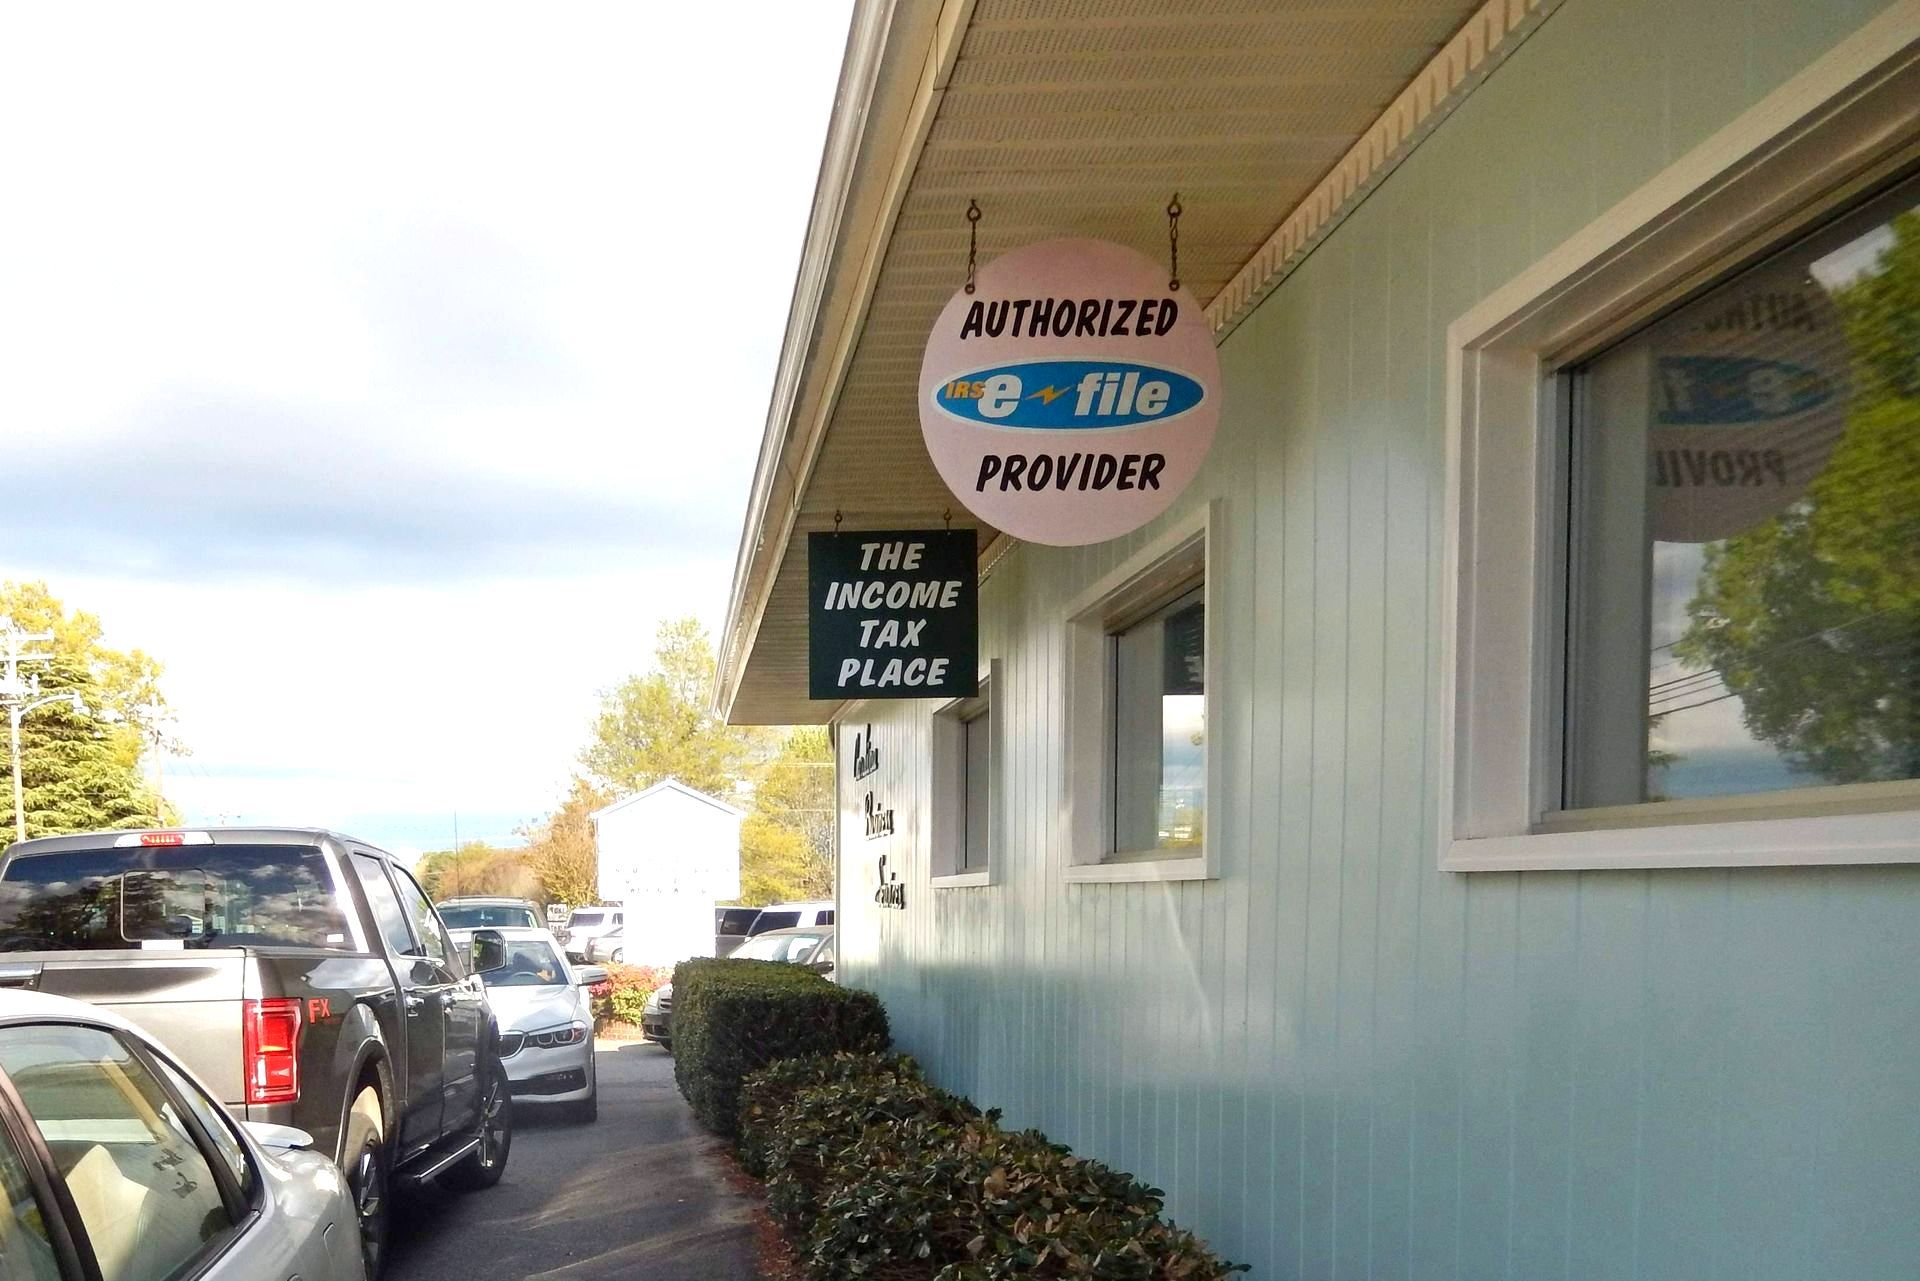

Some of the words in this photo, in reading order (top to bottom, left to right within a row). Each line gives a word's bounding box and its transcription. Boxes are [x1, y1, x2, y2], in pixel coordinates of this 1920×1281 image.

[960, 297, 1178, 340] AUTHORIZED
[945, 380, 985, 400] IRS
[976, 452, 1166, 492] PROVIDER
[860, 541, 926, 571] THE
[824, 580, 963, 611] INCOME
[859, 618, 928, 649] TAX
[837, 657, 950, 688] PLACE
